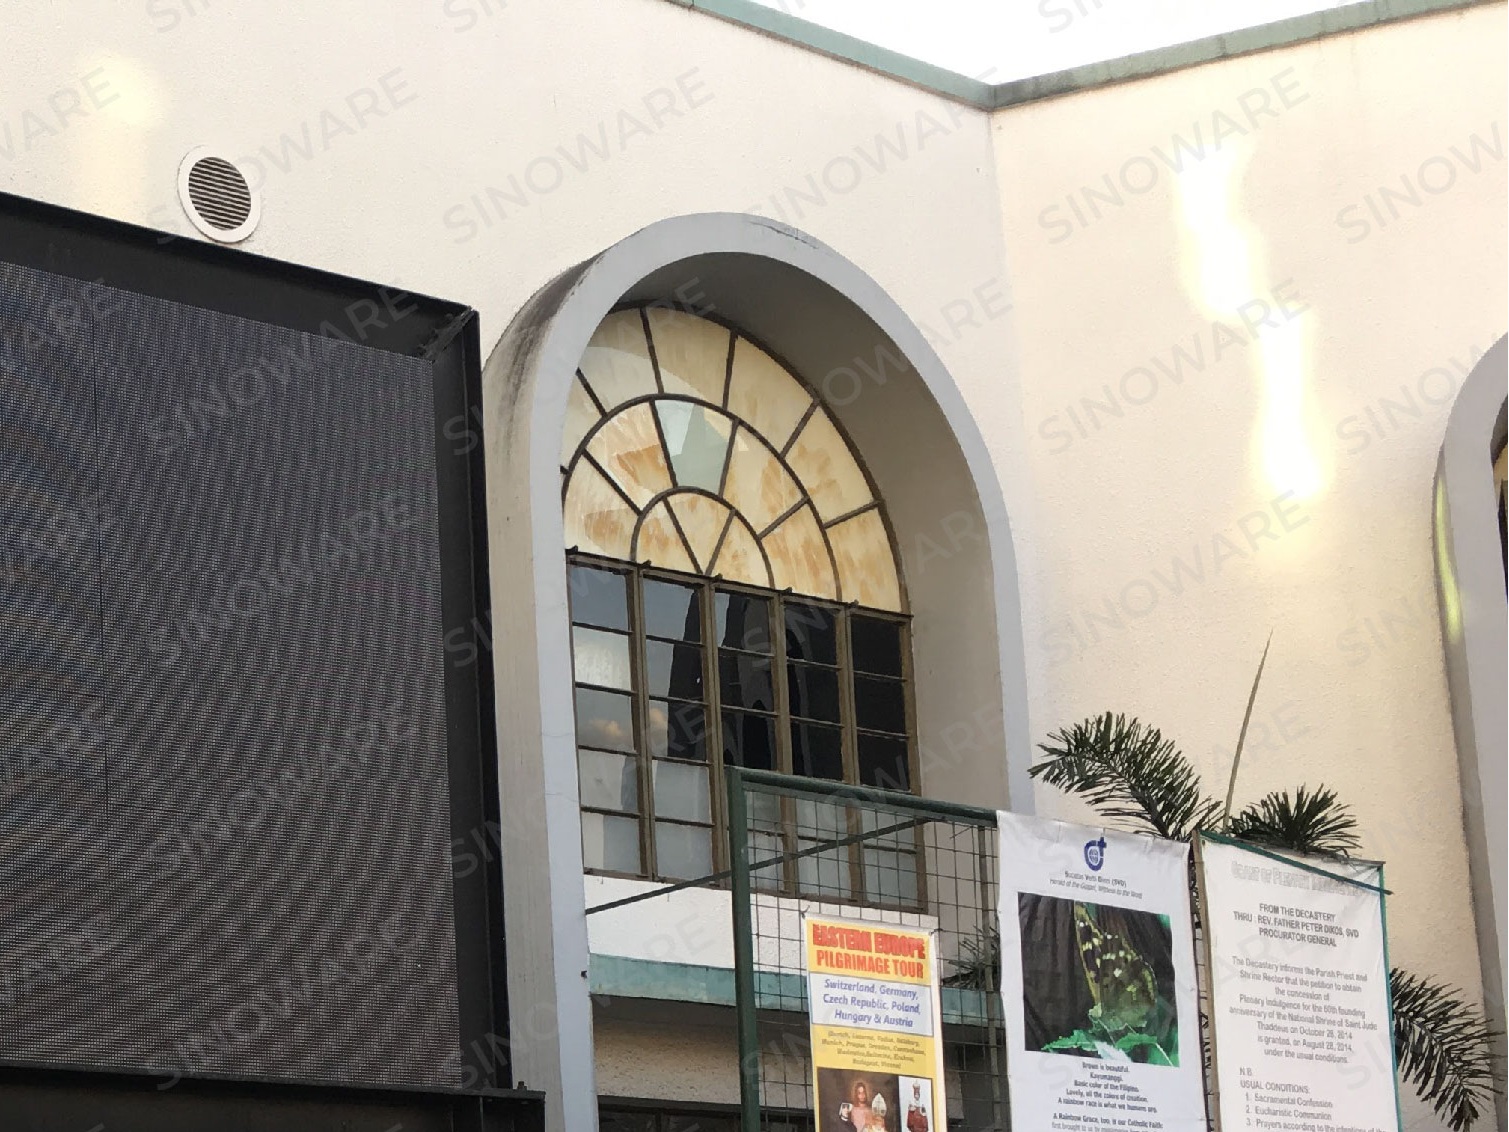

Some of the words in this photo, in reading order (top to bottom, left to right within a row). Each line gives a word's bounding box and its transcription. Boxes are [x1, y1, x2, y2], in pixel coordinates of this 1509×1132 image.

[1259, 903, 1279, 914] FROM
[1280, 906, 1294, 916] THE
[1295, 909, 1336, 922] DECASTERY
[1259, 927, 1307, 942] PROCURATOR
[1307, 934, 1337, 947] GENERAL
[816, 950, 891, 975] PILGRIMAGE
[893, 959, 924, 978] TOUR
[880, 985, 919, 1000] Germany,
[823, 993, 849, 1005] Czech
[851, 996, 889, 1010] Republic,
[891, 1000, 921, 1015] Poland,
[834, 1009, 873, 1024] Hungary
[884, 1017, 913, 1027] Austria
